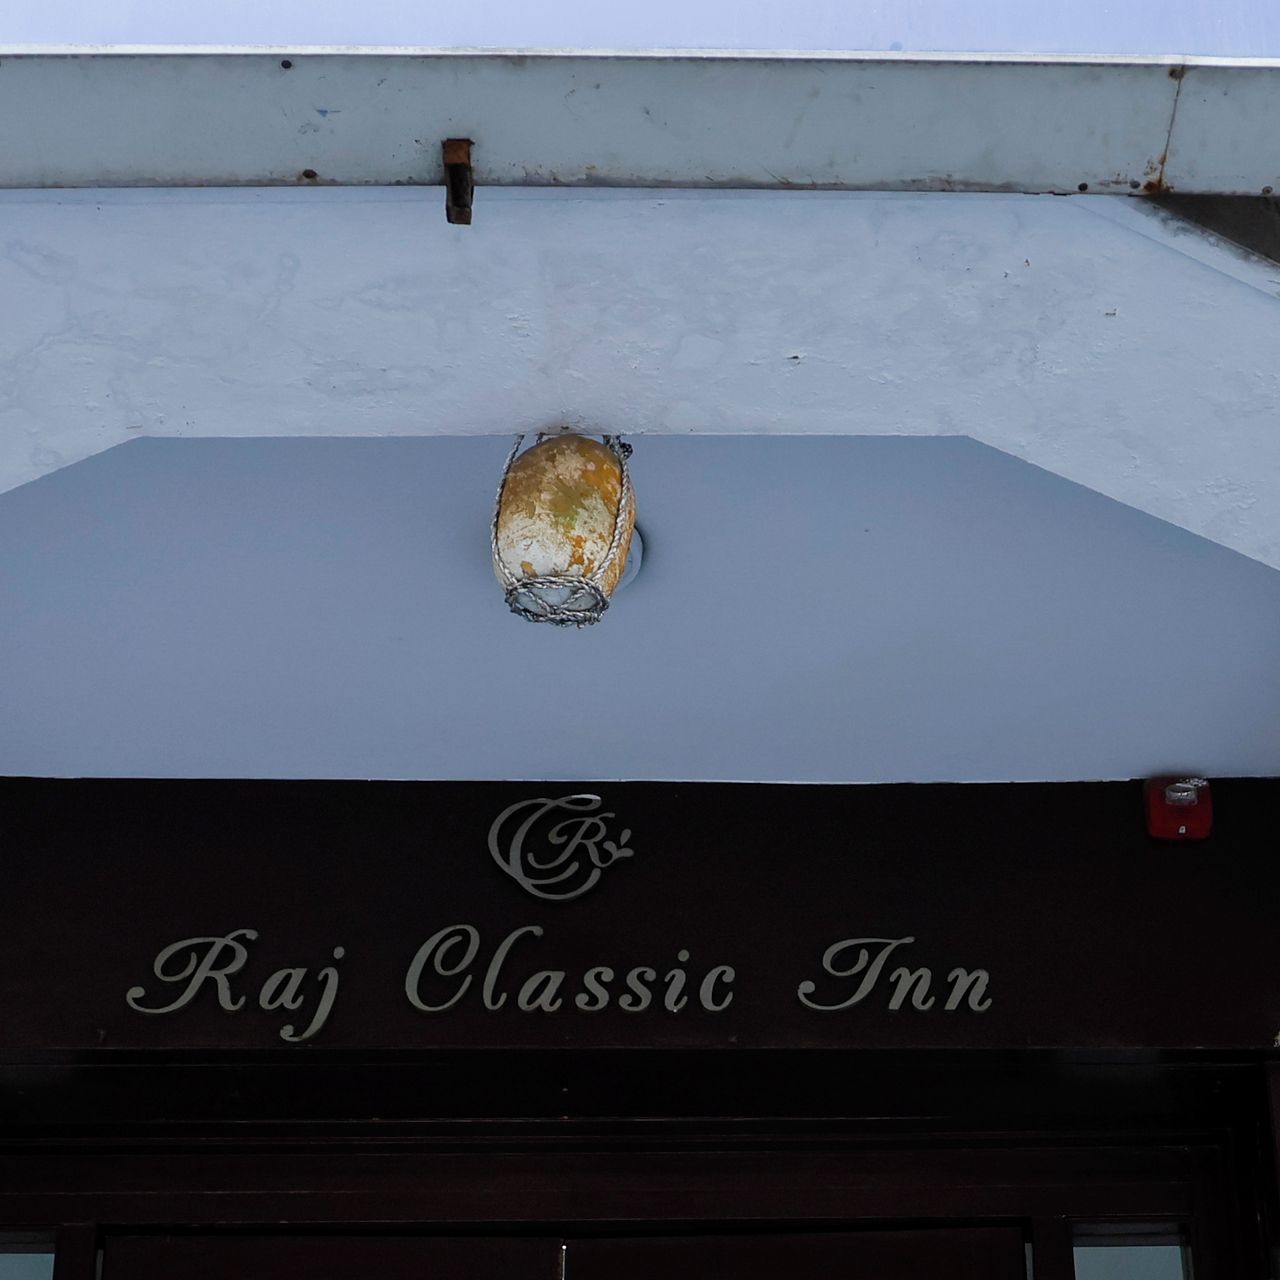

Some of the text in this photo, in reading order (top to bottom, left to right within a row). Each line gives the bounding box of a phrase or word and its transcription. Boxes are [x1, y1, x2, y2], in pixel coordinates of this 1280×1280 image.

[126, 923, 993, 1042] Raj Classic Inn
